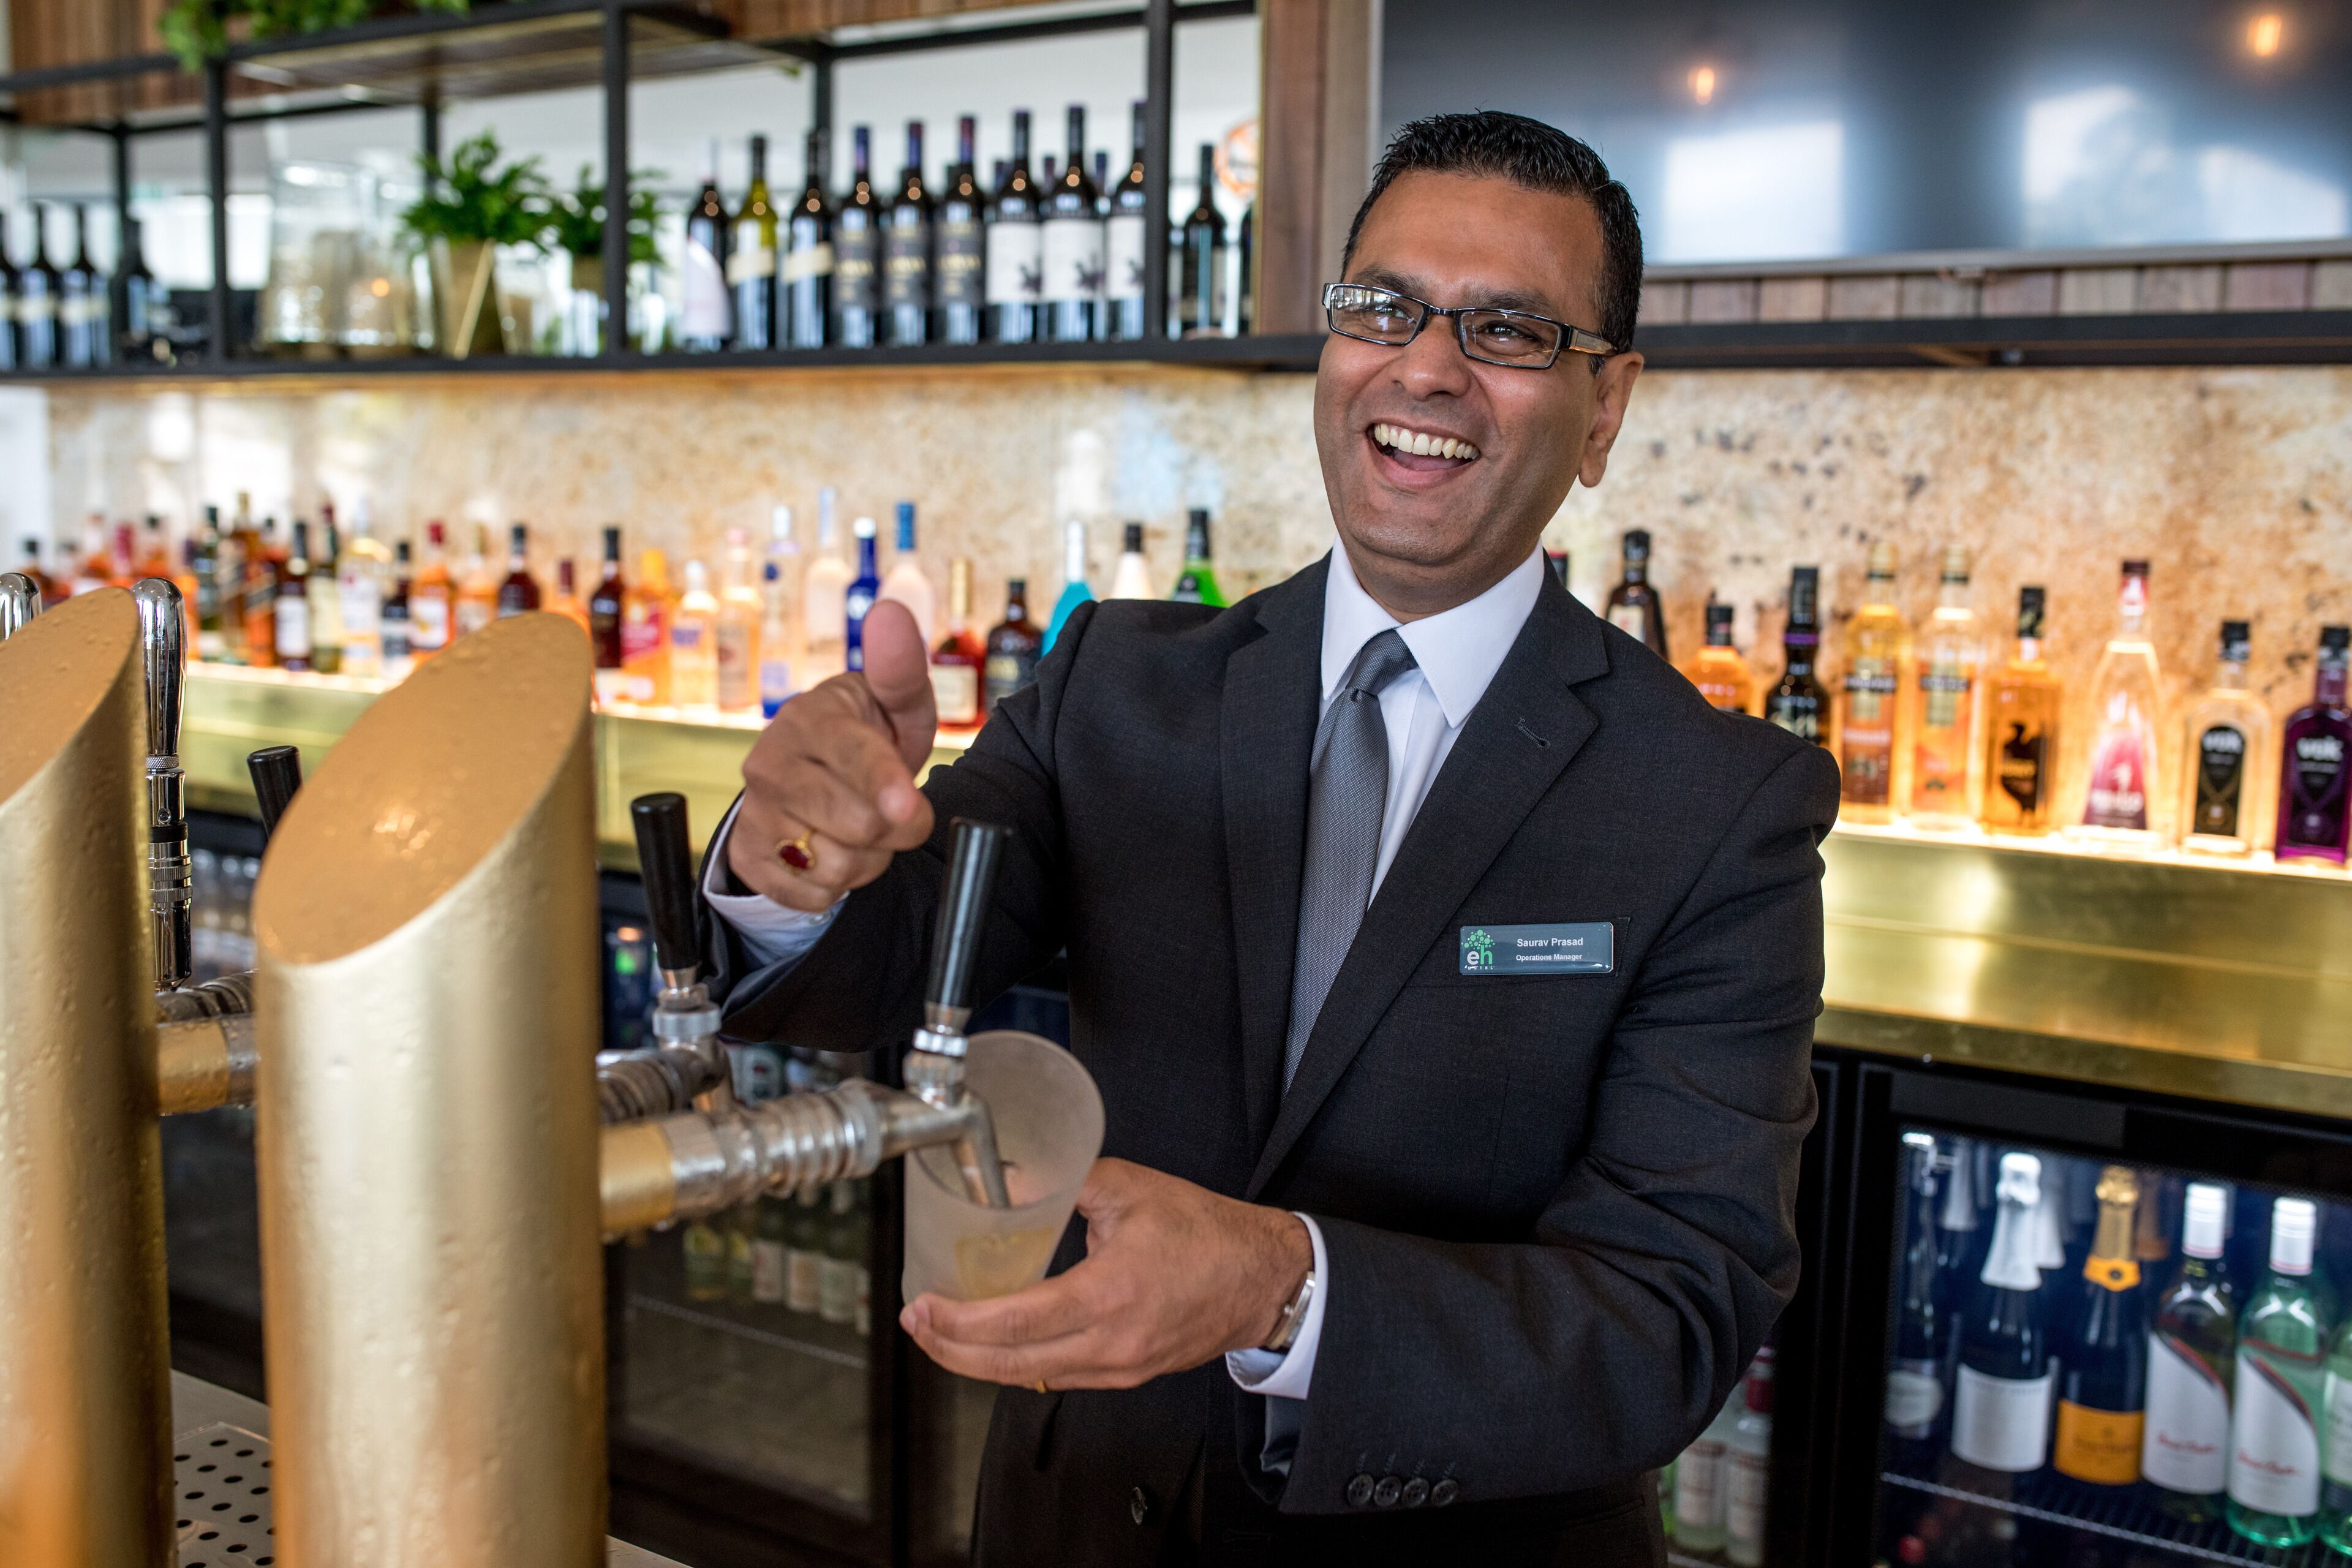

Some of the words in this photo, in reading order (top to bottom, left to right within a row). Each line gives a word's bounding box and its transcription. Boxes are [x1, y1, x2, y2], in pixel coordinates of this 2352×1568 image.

[1517, 938, 1549, 947] Saurav
[1551, 937, 1583, 946] Prasad
[1467, 944, 1493, 965] eh
